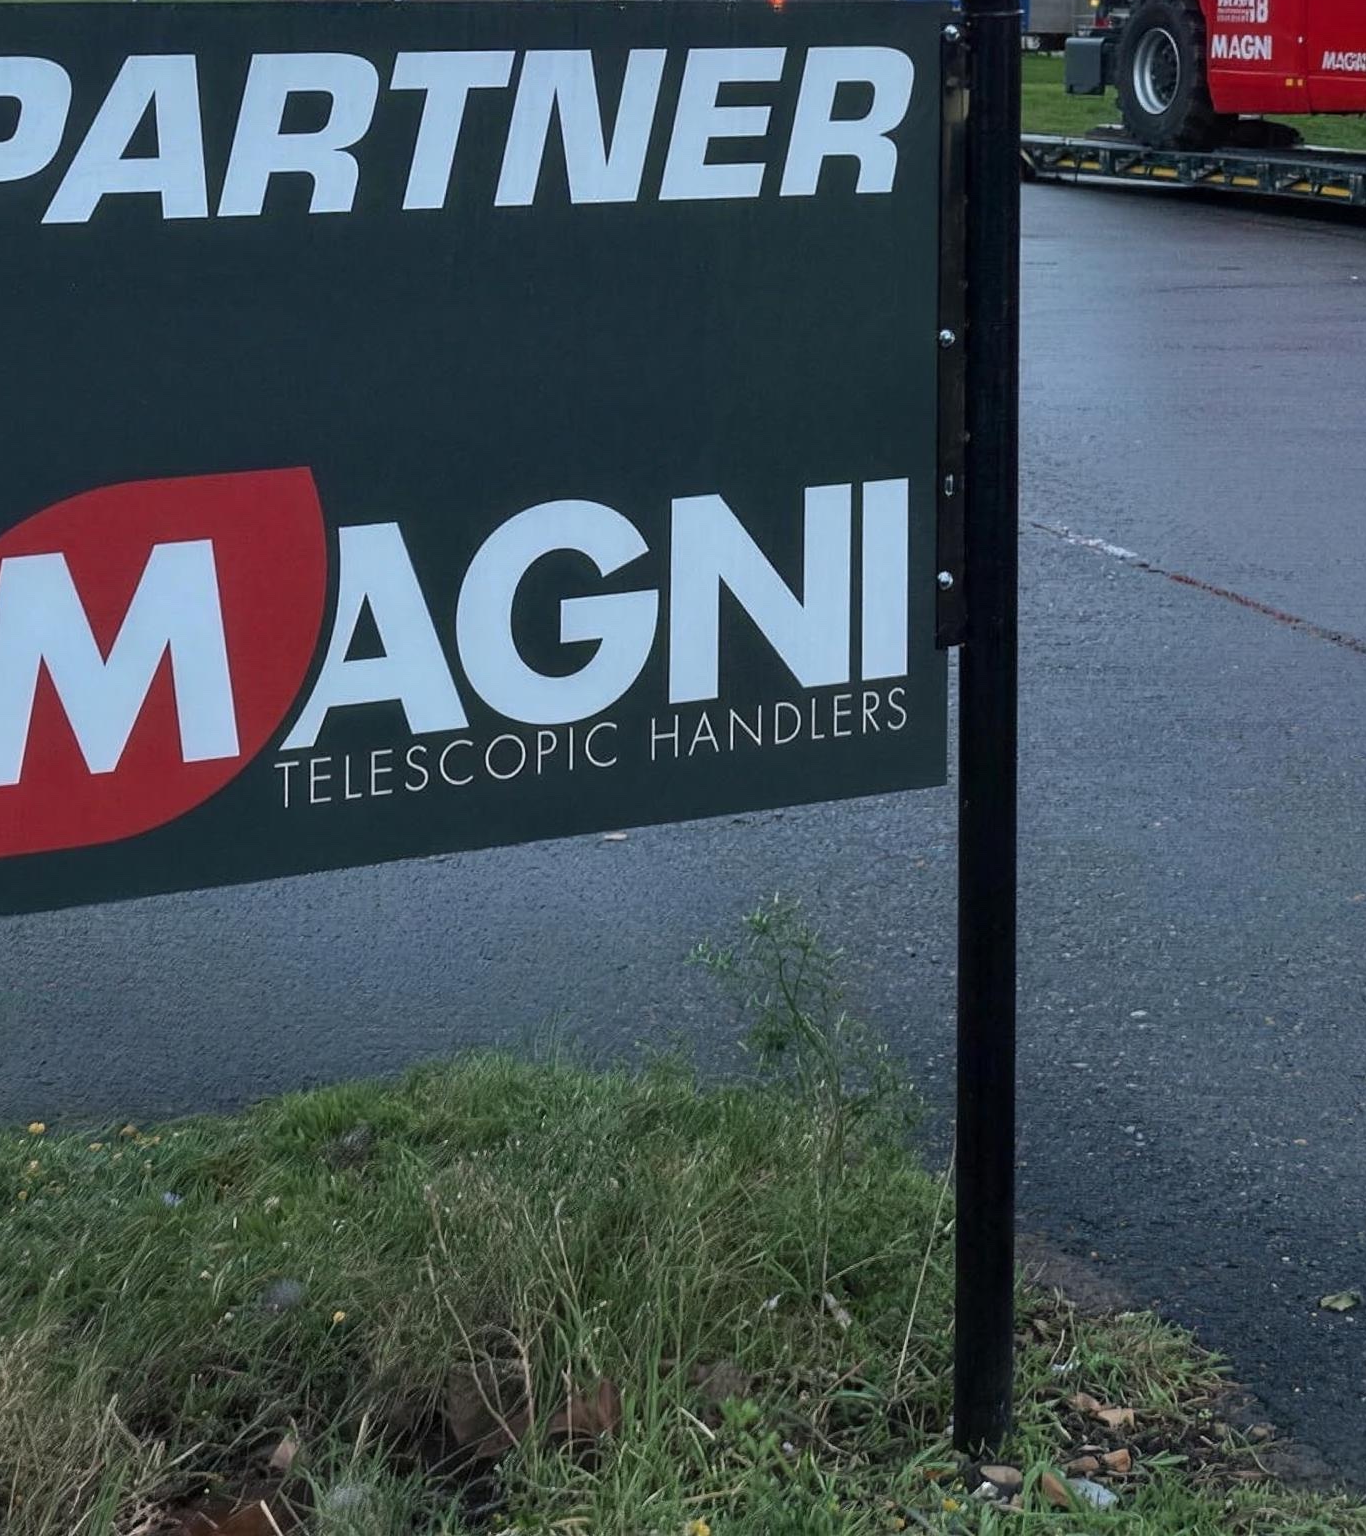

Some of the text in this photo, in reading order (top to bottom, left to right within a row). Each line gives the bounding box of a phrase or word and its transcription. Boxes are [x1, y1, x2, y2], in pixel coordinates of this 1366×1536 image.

[1210, 33, 1273, 61] MAGNI
[274, 687, 908, 809] TELESCOPIC HANDLERS
